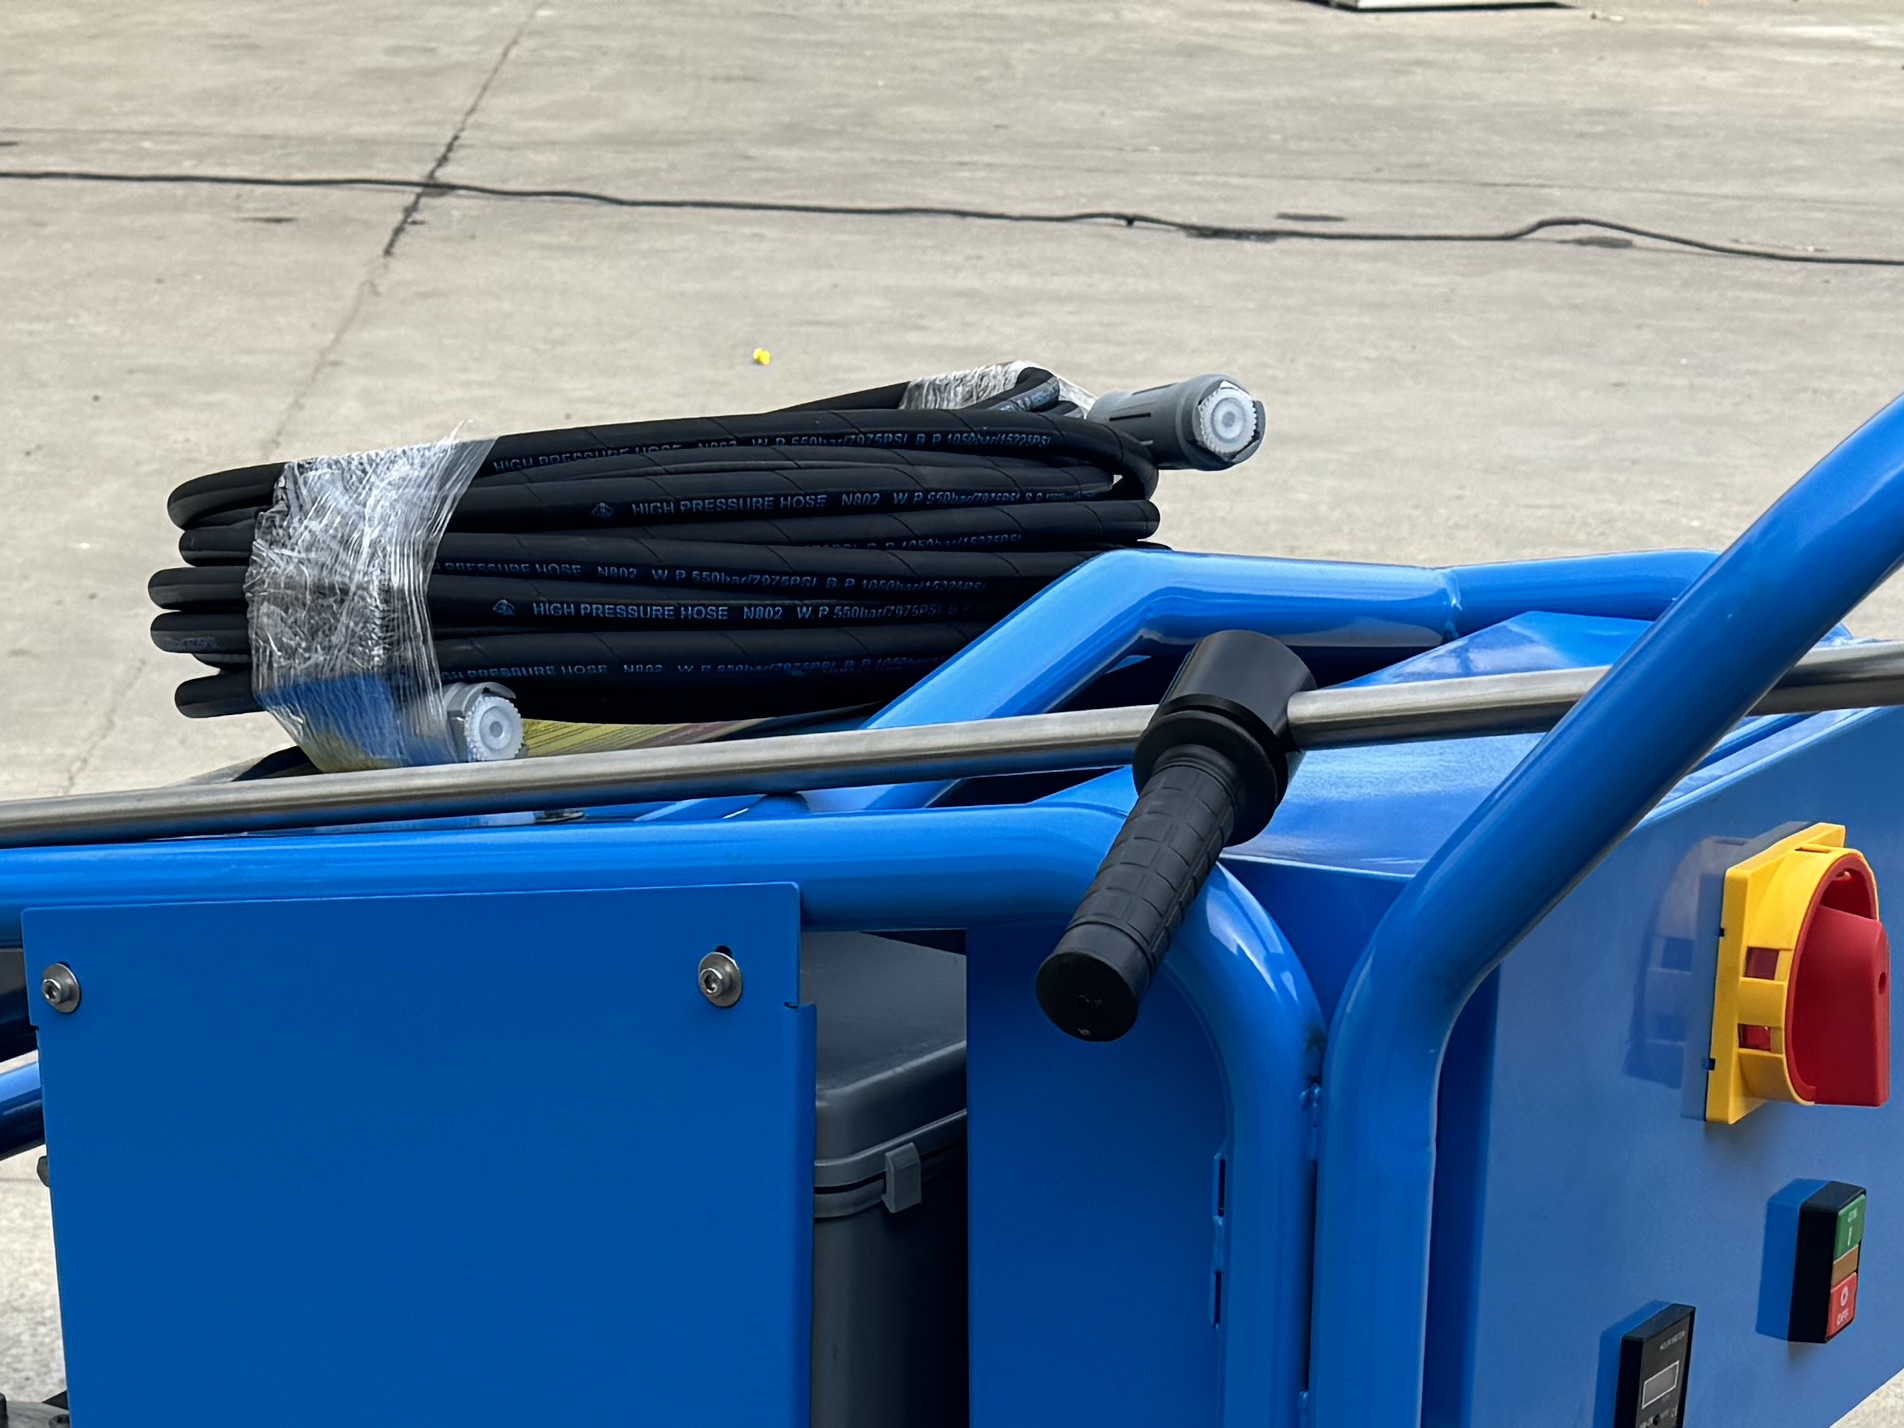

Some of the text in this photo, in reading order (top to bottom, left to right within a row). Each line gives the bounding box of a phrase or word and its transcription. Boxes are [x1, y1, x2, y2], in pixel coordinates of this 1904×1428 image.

[632, 502, 674, 516] HIGH
[680, 497, 774, 512] PRESSURE
[780, 494, 827, 508] HOSE
[841, 492, 880, 506] N802
[535, 563, 582, 576] HOSE
[597, 565, 637, 579] N802
[533, 602, 575, 616] HIGH
[580, 603, 675, 619] PRESSURE
[681, 605, 728, 620] HOSE
[743, 606, 783, 620] N802
[561, 664, 608, 676] HOSE
